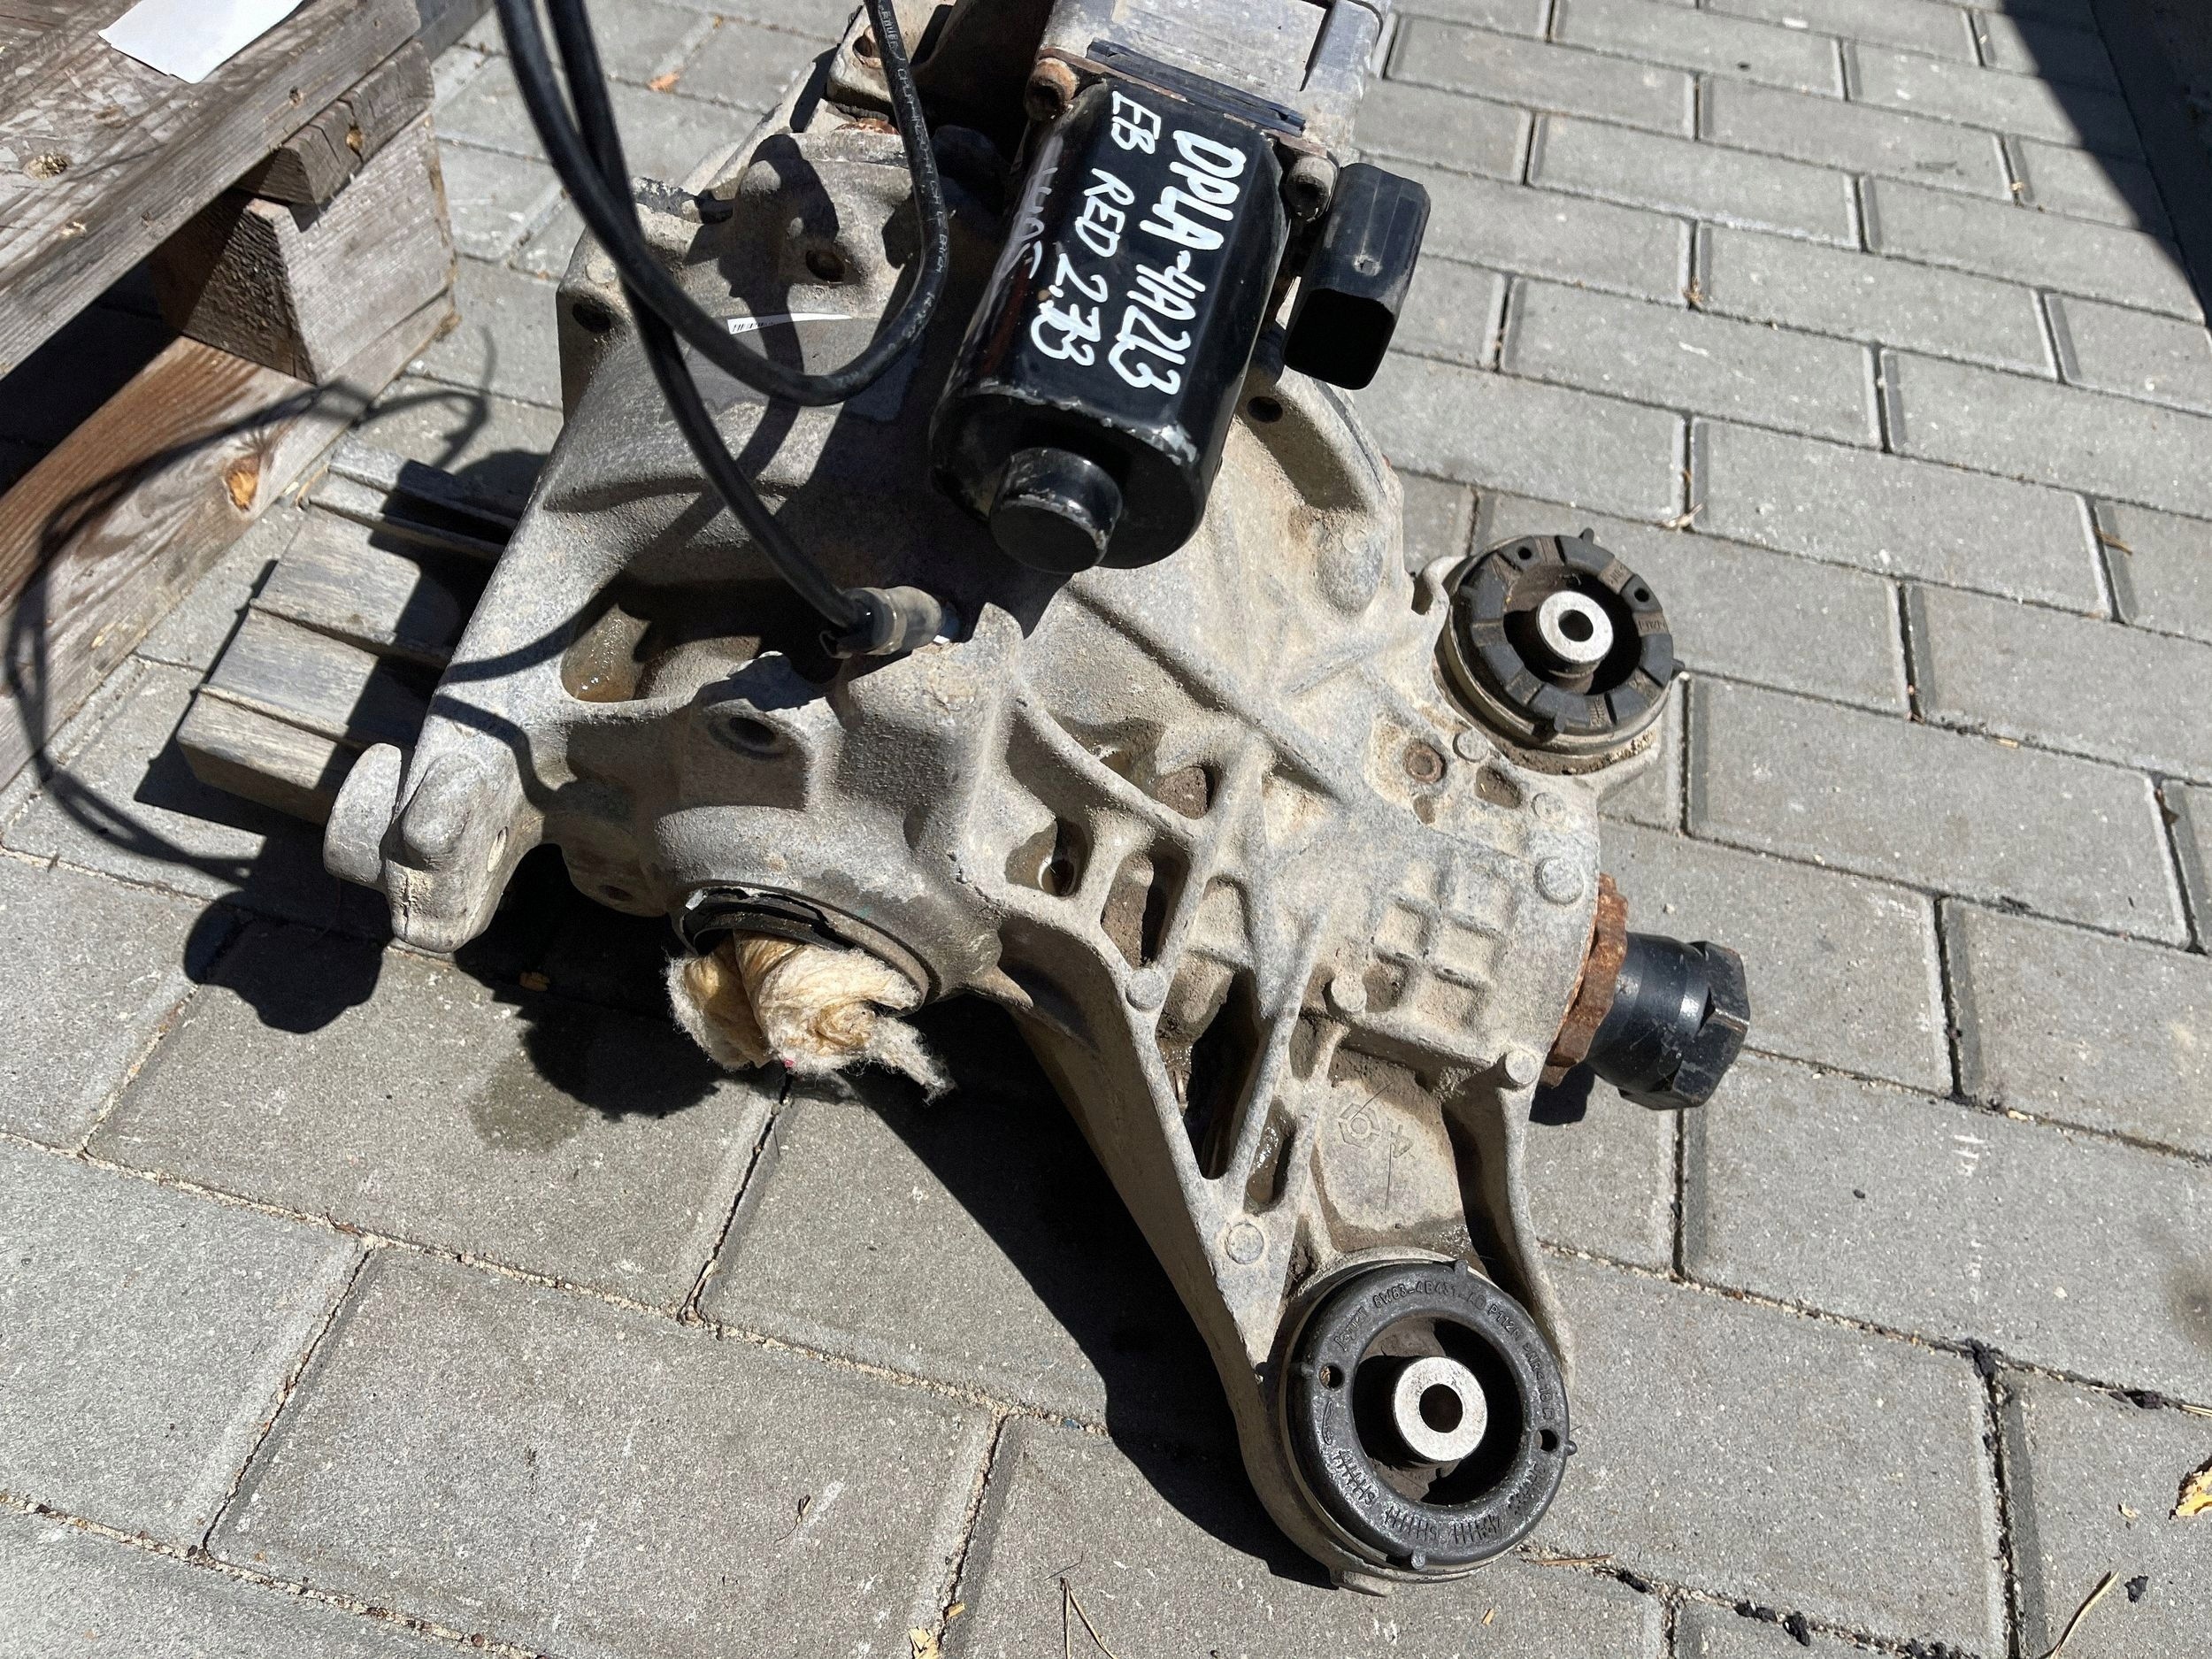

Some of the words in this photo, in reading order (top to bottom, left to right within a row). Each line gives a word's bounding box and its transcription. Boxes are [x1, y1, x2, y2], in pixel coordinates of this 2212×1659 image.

[1111, 90, 1161, 154] EB
[1075, 168, 1135, 257] RED
[1031, 253, 1108, 366] 2.73
